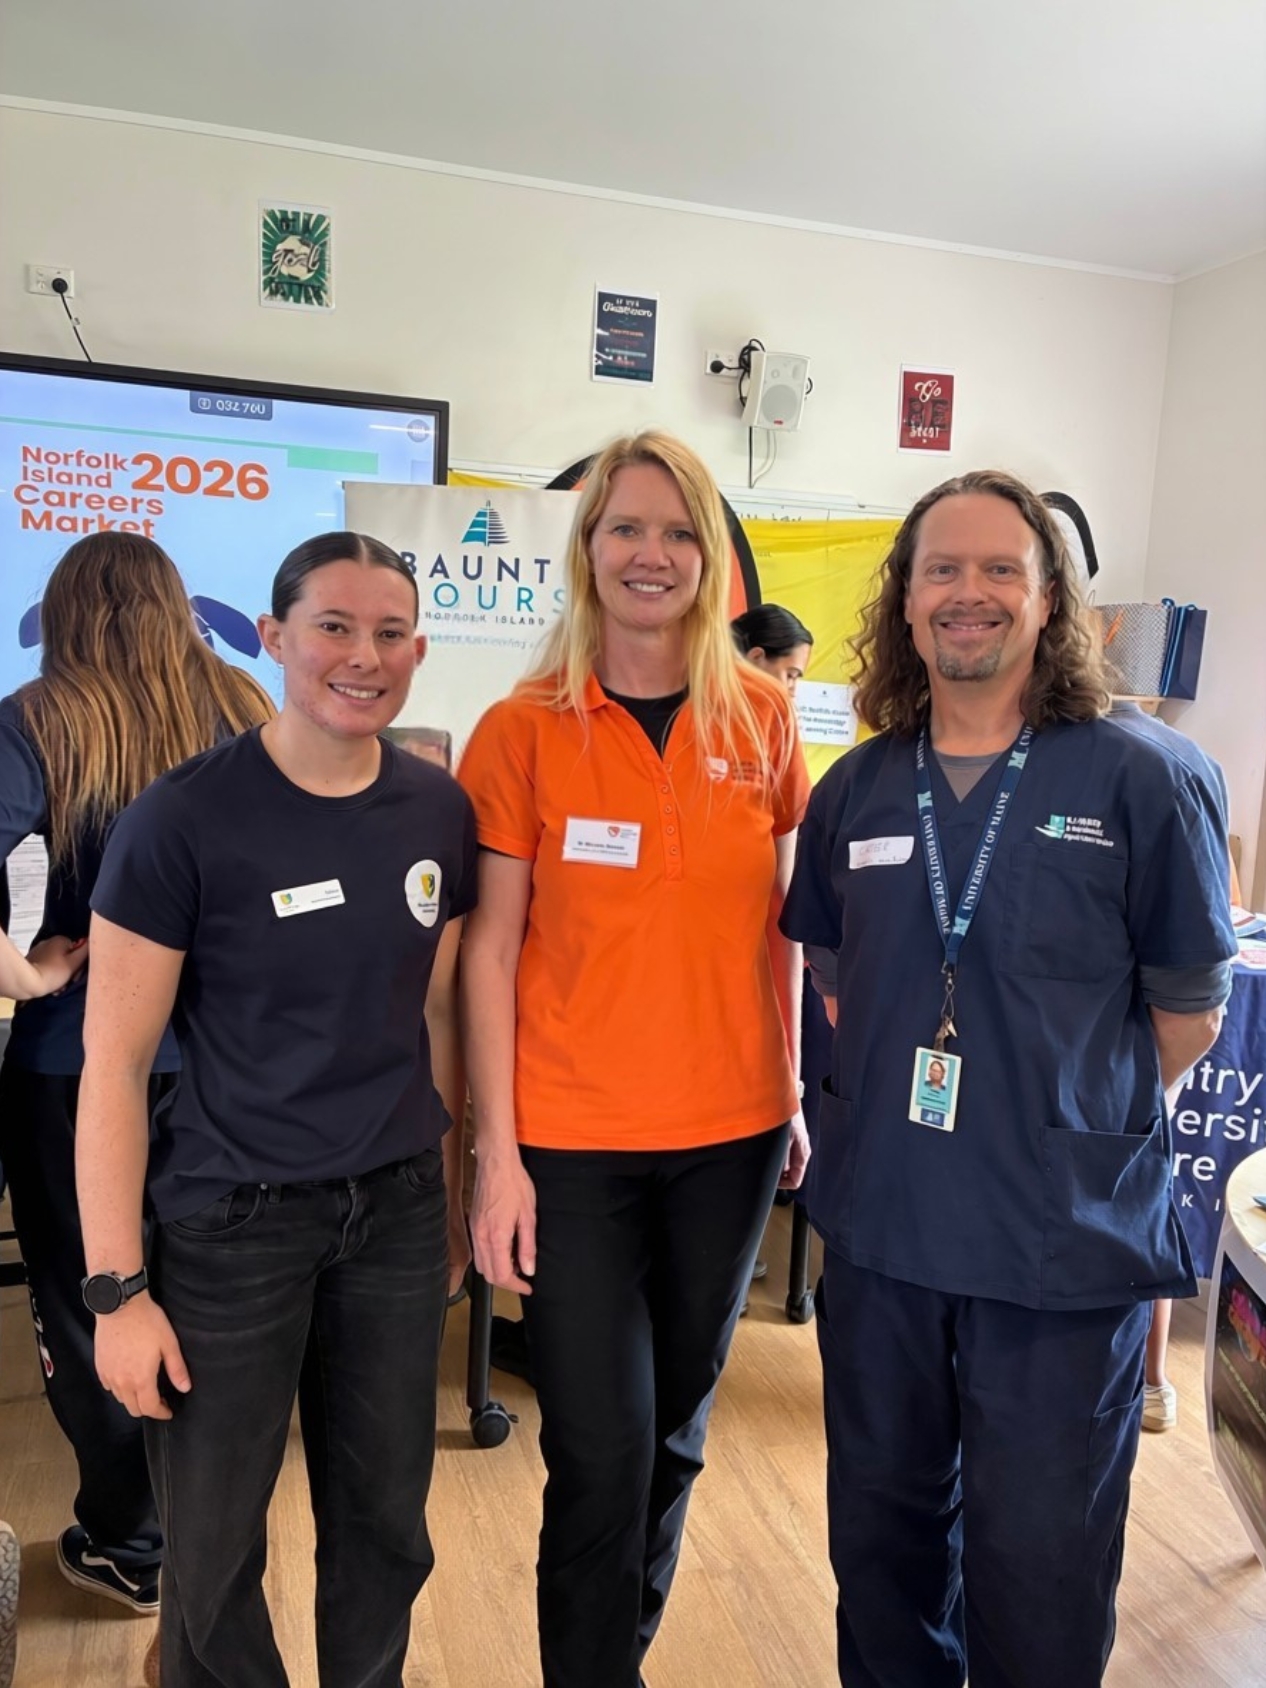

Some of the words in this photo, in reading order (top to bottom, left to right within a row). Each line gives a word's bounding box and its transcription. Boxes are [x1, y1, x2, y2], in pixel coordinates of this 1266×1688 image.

[22, 445, 129, 472] Norfolk
[22, 465, 113, 489] Island
[131, 452, 270, 501] 2026
[13, 484, 164, 516] Careers
[21, 508, 156, 538] Market
[432, 582, 567, 614] OURS
[961, 846, 992, 911] UNIVERSITY
[984, 827, 997, 845] OF
[1176, 1107, 1266, 1143] ersi
